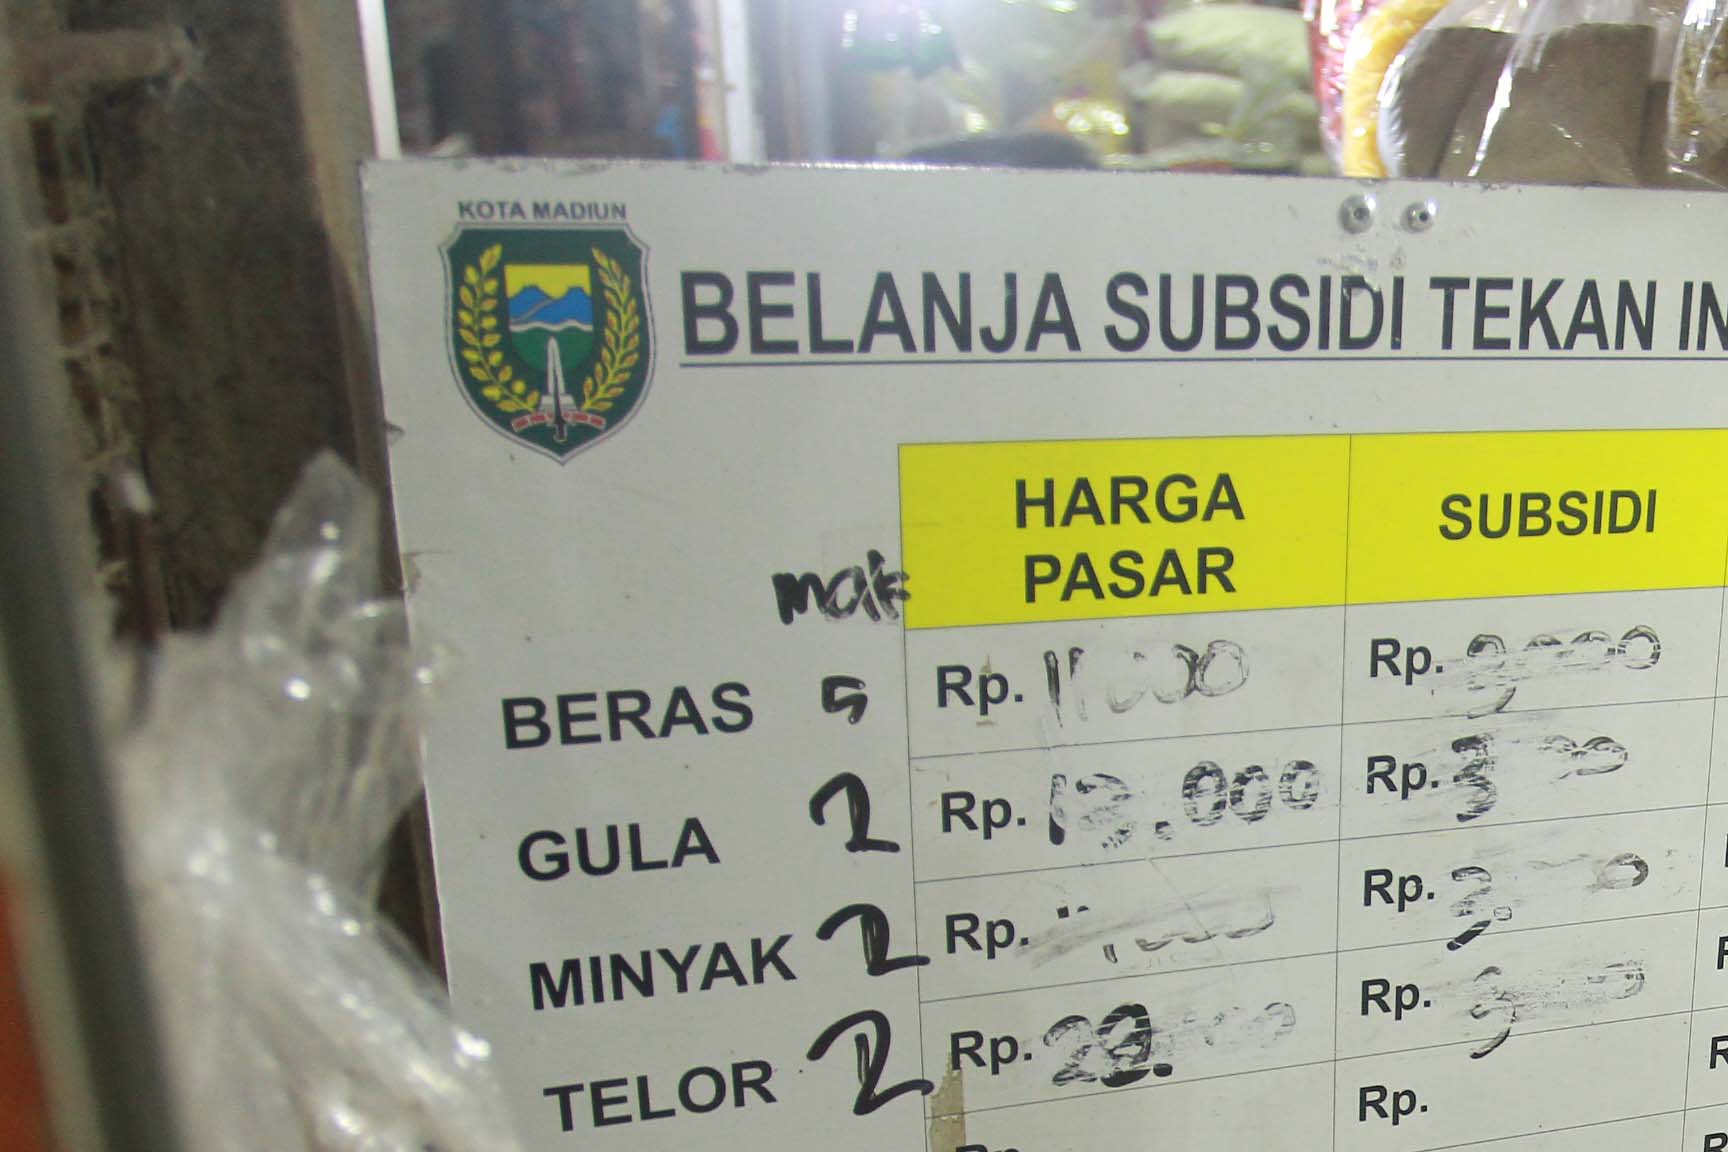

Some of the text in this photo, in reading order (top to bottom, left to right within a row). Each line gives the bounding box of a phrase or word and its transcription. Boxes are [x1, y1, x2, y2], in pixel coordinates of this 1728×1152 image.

[457, 201, 626, 220] KOTA MADIUN
[680, 270, 1083, 357] BELANJA
[1103, 271, 1402, 354] SUBSIDI
[1429, 276, 1658, 352] TEKAN
[1015, 473, 1246, 529] HARGA
[1438, 489, 1657, 541] SUBSIDI
[1024, 546, 1236, 604] PASAR
[1370, 638, 1444, 686] Rp.
[501, 682, 754, 750] BERAS
[936, 664, 1023, 716] Rp.
[1366, 755, 1439, 801] Rp.
[808, 772, 901, 853] 2
[941, 791, 1026, 841] Rp.
[518, 817, 721, 882] GULA
[1363, 868, 1435, 913] Rp.
[815, 903, 931, 977] 2
[945, 912, 1029, 960] Rp.
[529, 934, 797, 1011] MINYAK
[1361, 978, 1431, 1021] Rp.
[806, 1009, 935, 1116] 2
[950, 1030, 1033, 1076] Rp.
[542, 1060, 777, 1132] TELOR
[1358, 1085, 1428, 1126] Rp.
